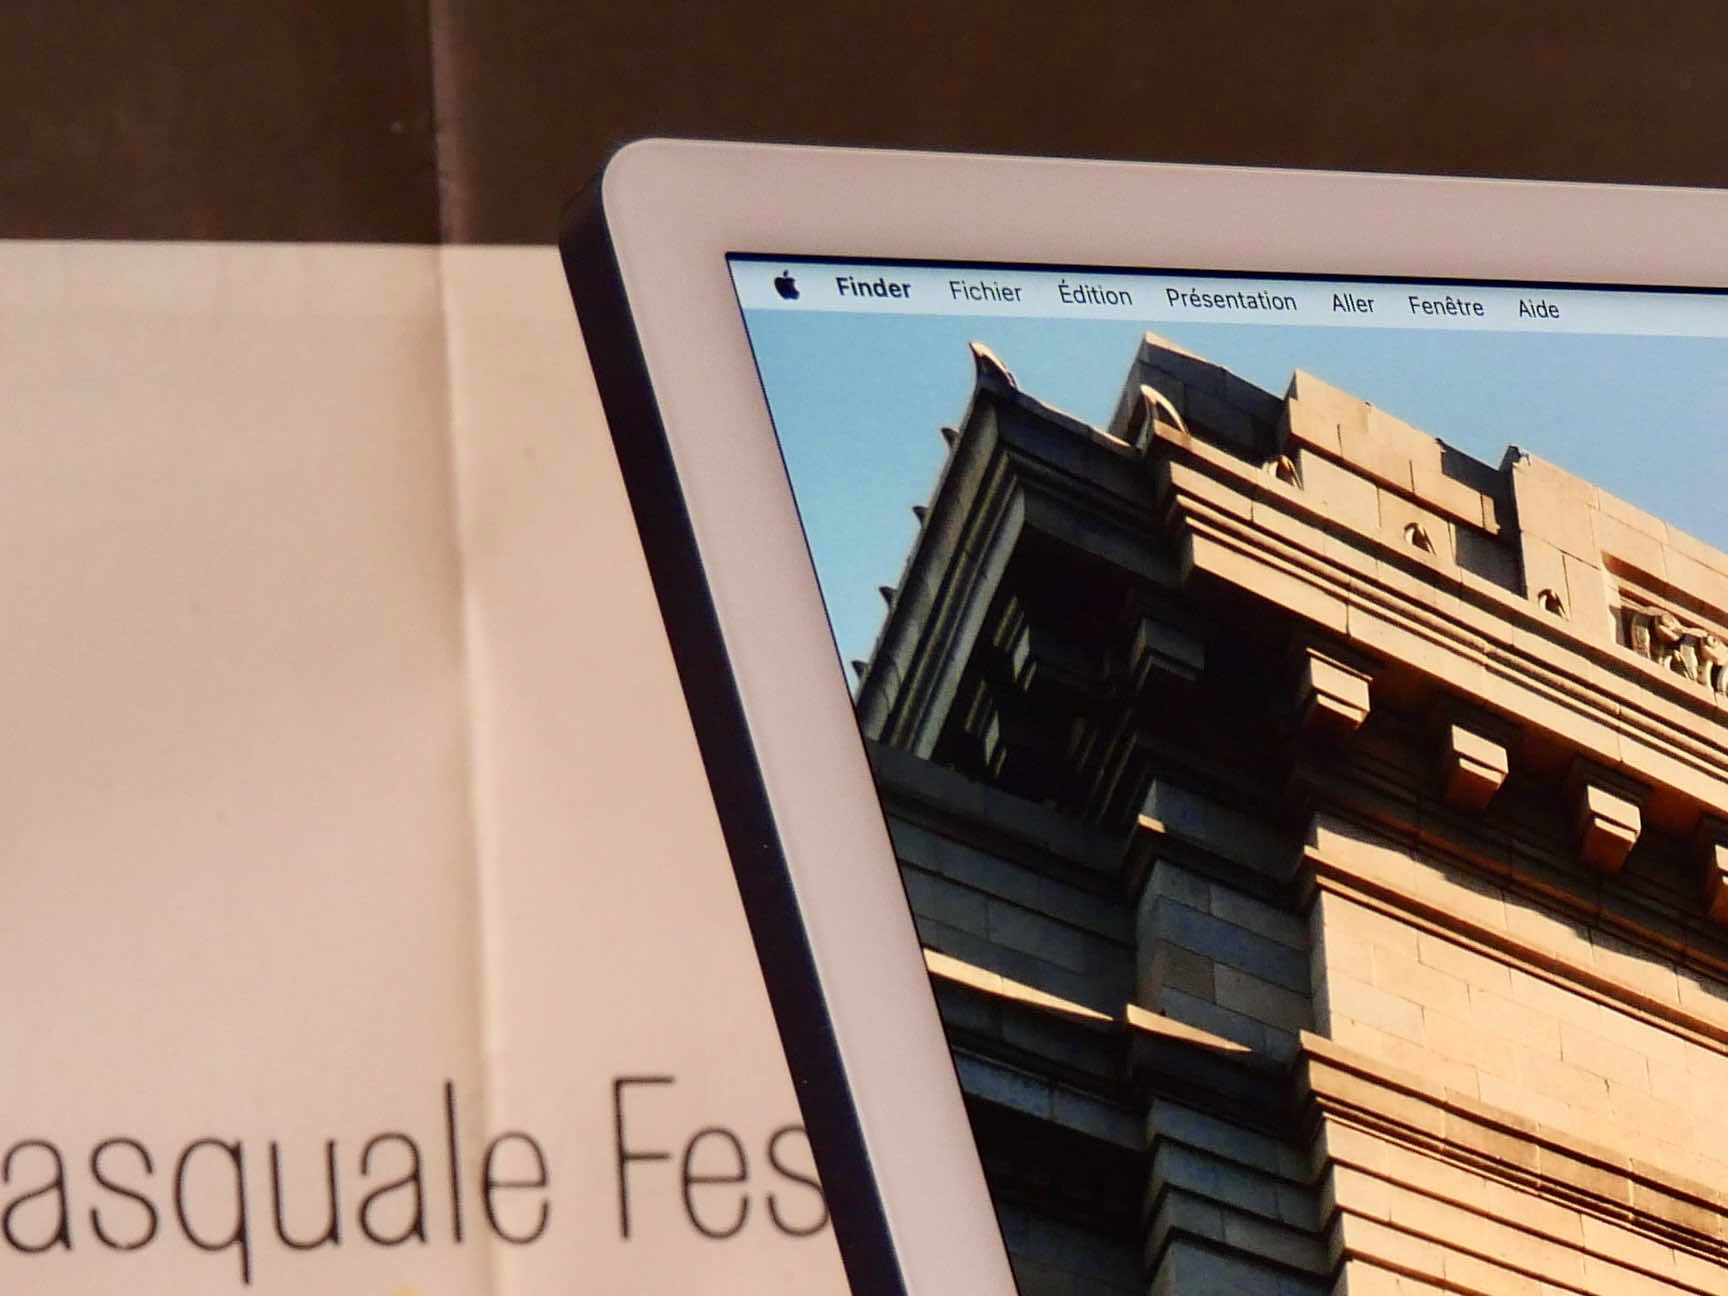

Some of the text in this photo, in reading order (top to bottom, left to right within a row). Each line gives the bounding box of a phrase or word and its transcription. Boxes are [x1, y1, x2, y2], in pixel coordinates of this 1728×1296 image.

[836, 276, 1561, 319] Finder Fichier Édition Présentation Aller Fenêtre Aide
[1, 1075, 831, 1286] asquale Fes
